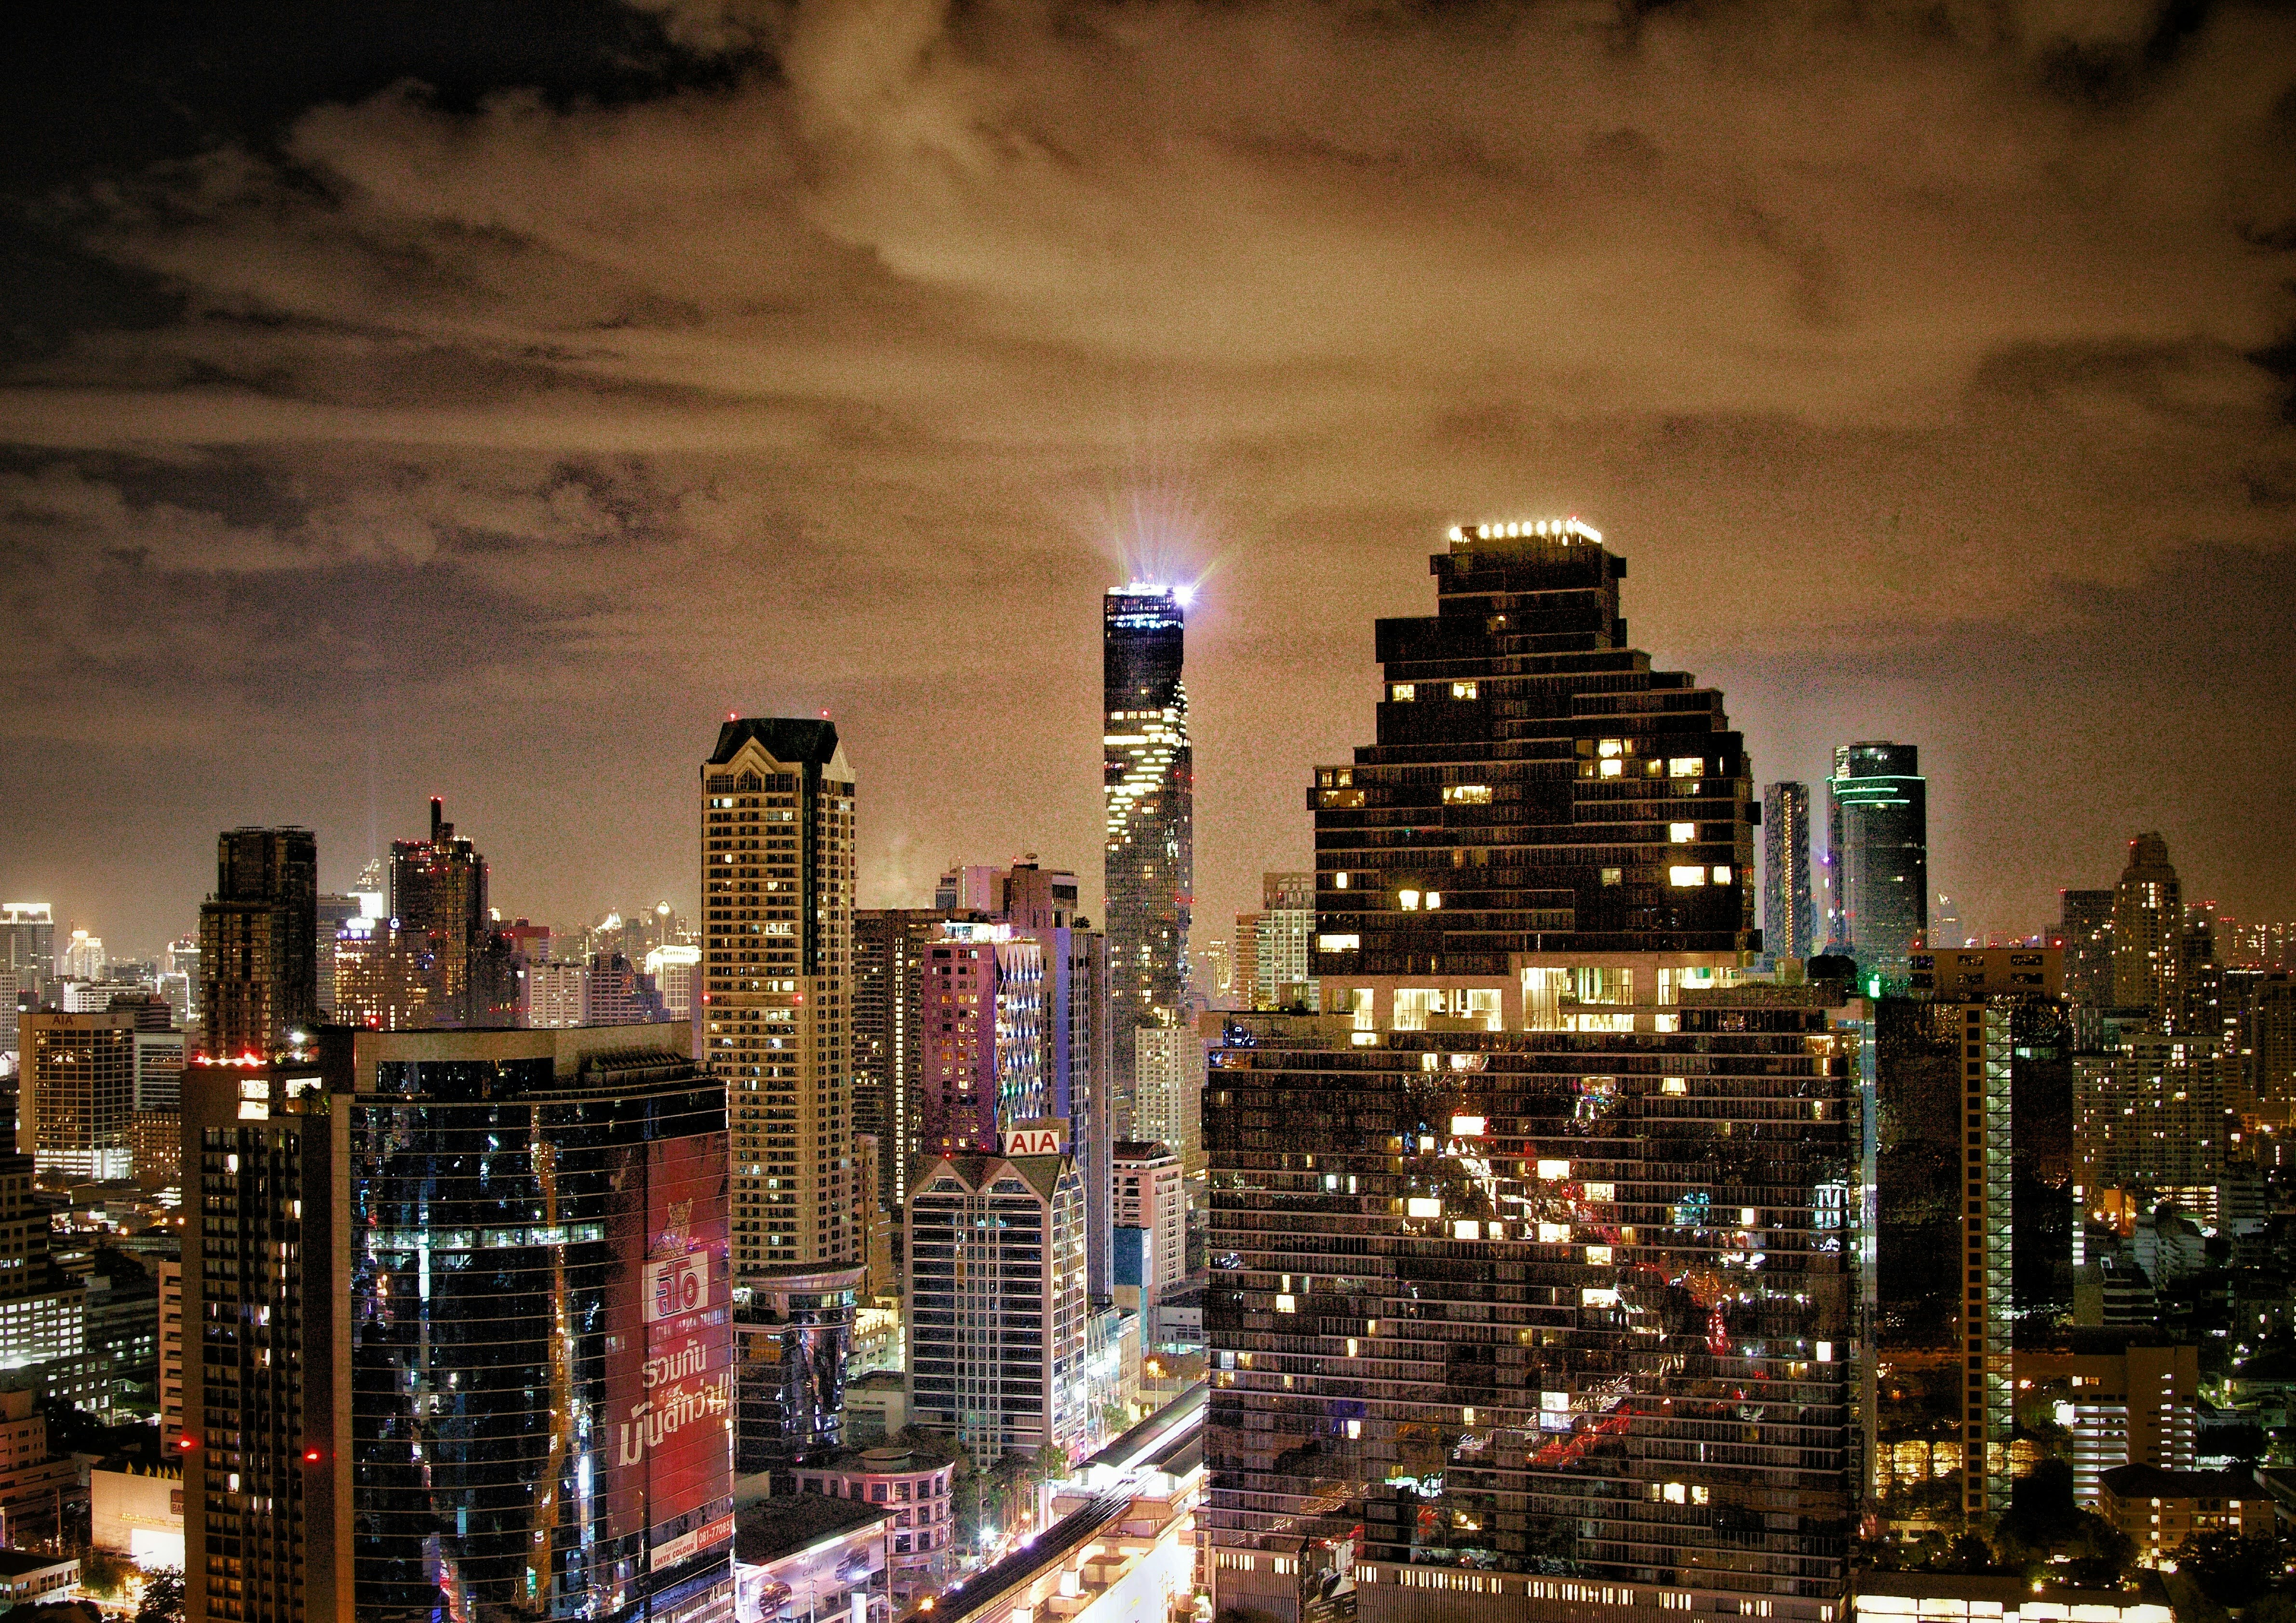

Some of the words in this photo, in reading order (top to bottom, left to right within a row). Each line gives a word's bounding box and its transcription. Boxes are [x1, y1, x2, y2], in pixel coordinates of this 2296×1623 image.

[150, 994, 162, 1002] AIA
[53, 1014, 73, 1026] AIA
[1009, 1133, 1057, 1153] AIA
[656, 1257, 699, 1317] ลีโอ
[642, 1339, 706, 1388] รวมกัน
[654, 1553, 671, 1567] CMYK
[672, 1542, 694, 1558] COLOUR
[802, 1563, 823, 1576] CR-V
